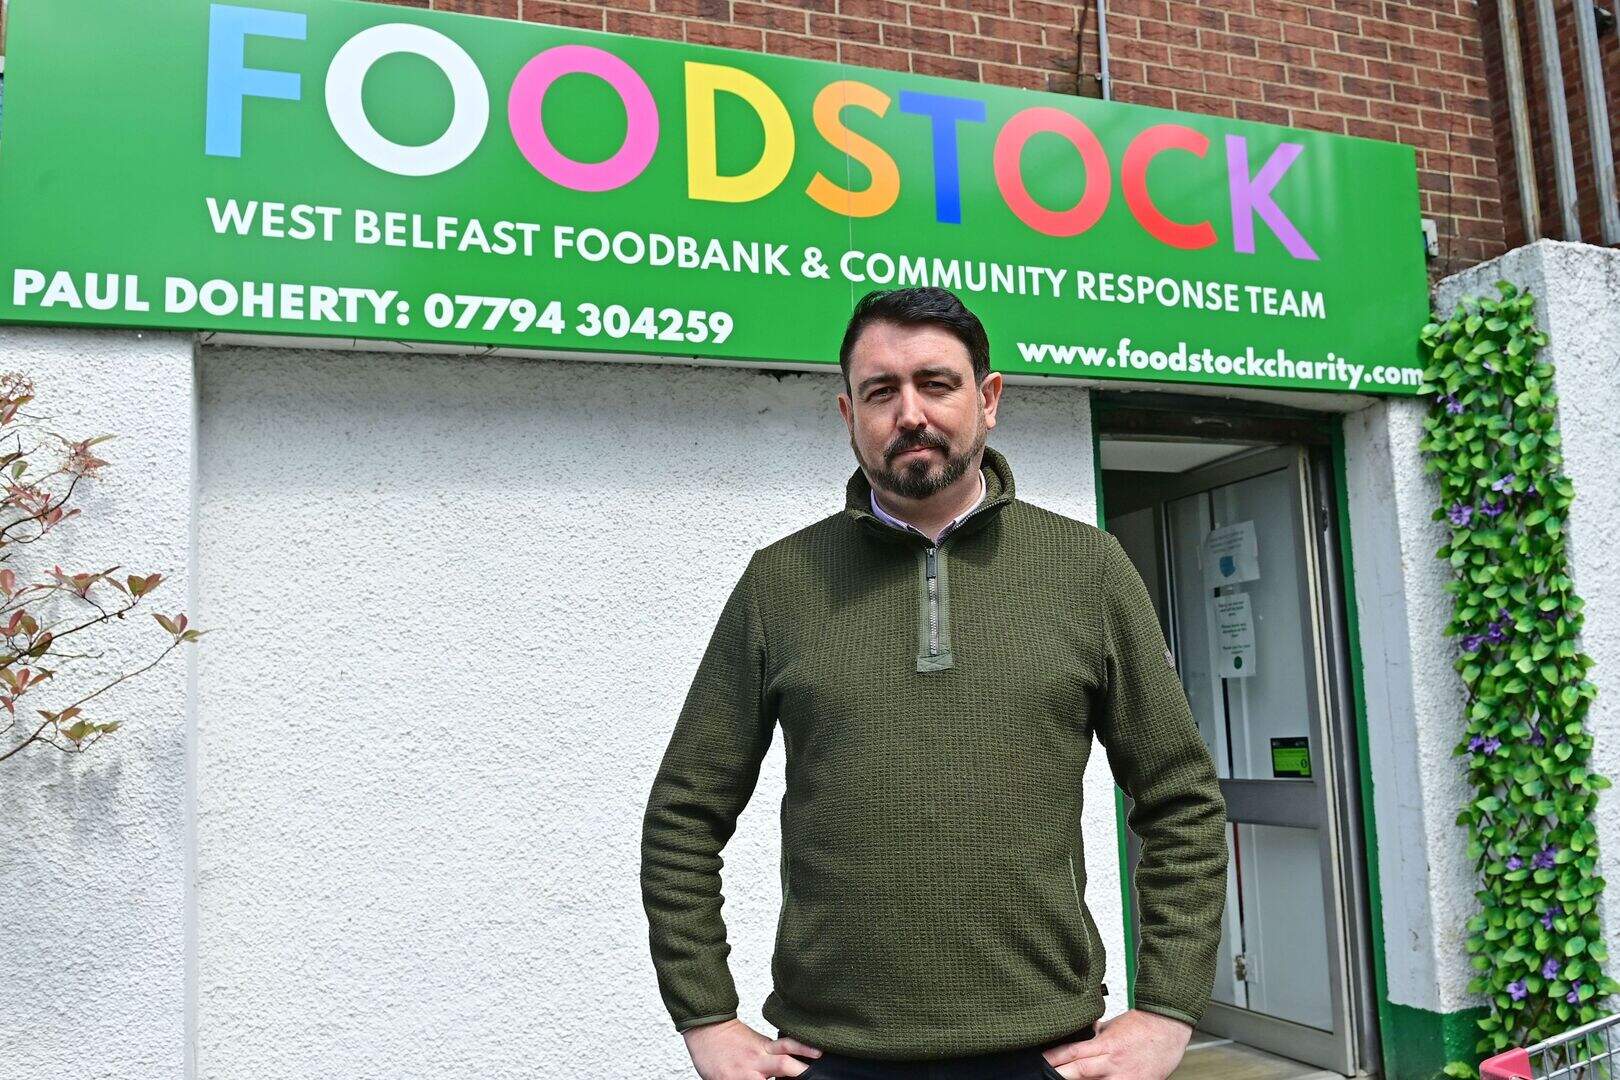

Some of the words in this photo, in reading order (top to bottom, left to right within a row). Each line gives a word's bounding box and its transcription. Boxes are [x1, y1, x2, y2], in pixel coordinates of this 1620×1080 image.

[205, 3, 1320, 261] FOODSTOCK
[13, 268, 150, 312] PAUL
[164, 276, 410, 326] DOHERTY:
[423, 292, 566, 335] 07794
[575, 302, 734, 344] 304259
[206, 197, 342, 242] WEST
[354, 208, 541, 257] BELFAST
[554, 225, 791, 276] FOODBANK
[800, 246, 831, 279] &
[839, 250, 1068, 298] COMMUNITY
[1076, 270, 1240, 312] RESPONSE
[1244, 285, 1326, 319] TEAM
[1016, 336, 1425, 390] www.foodstockcharity.com
